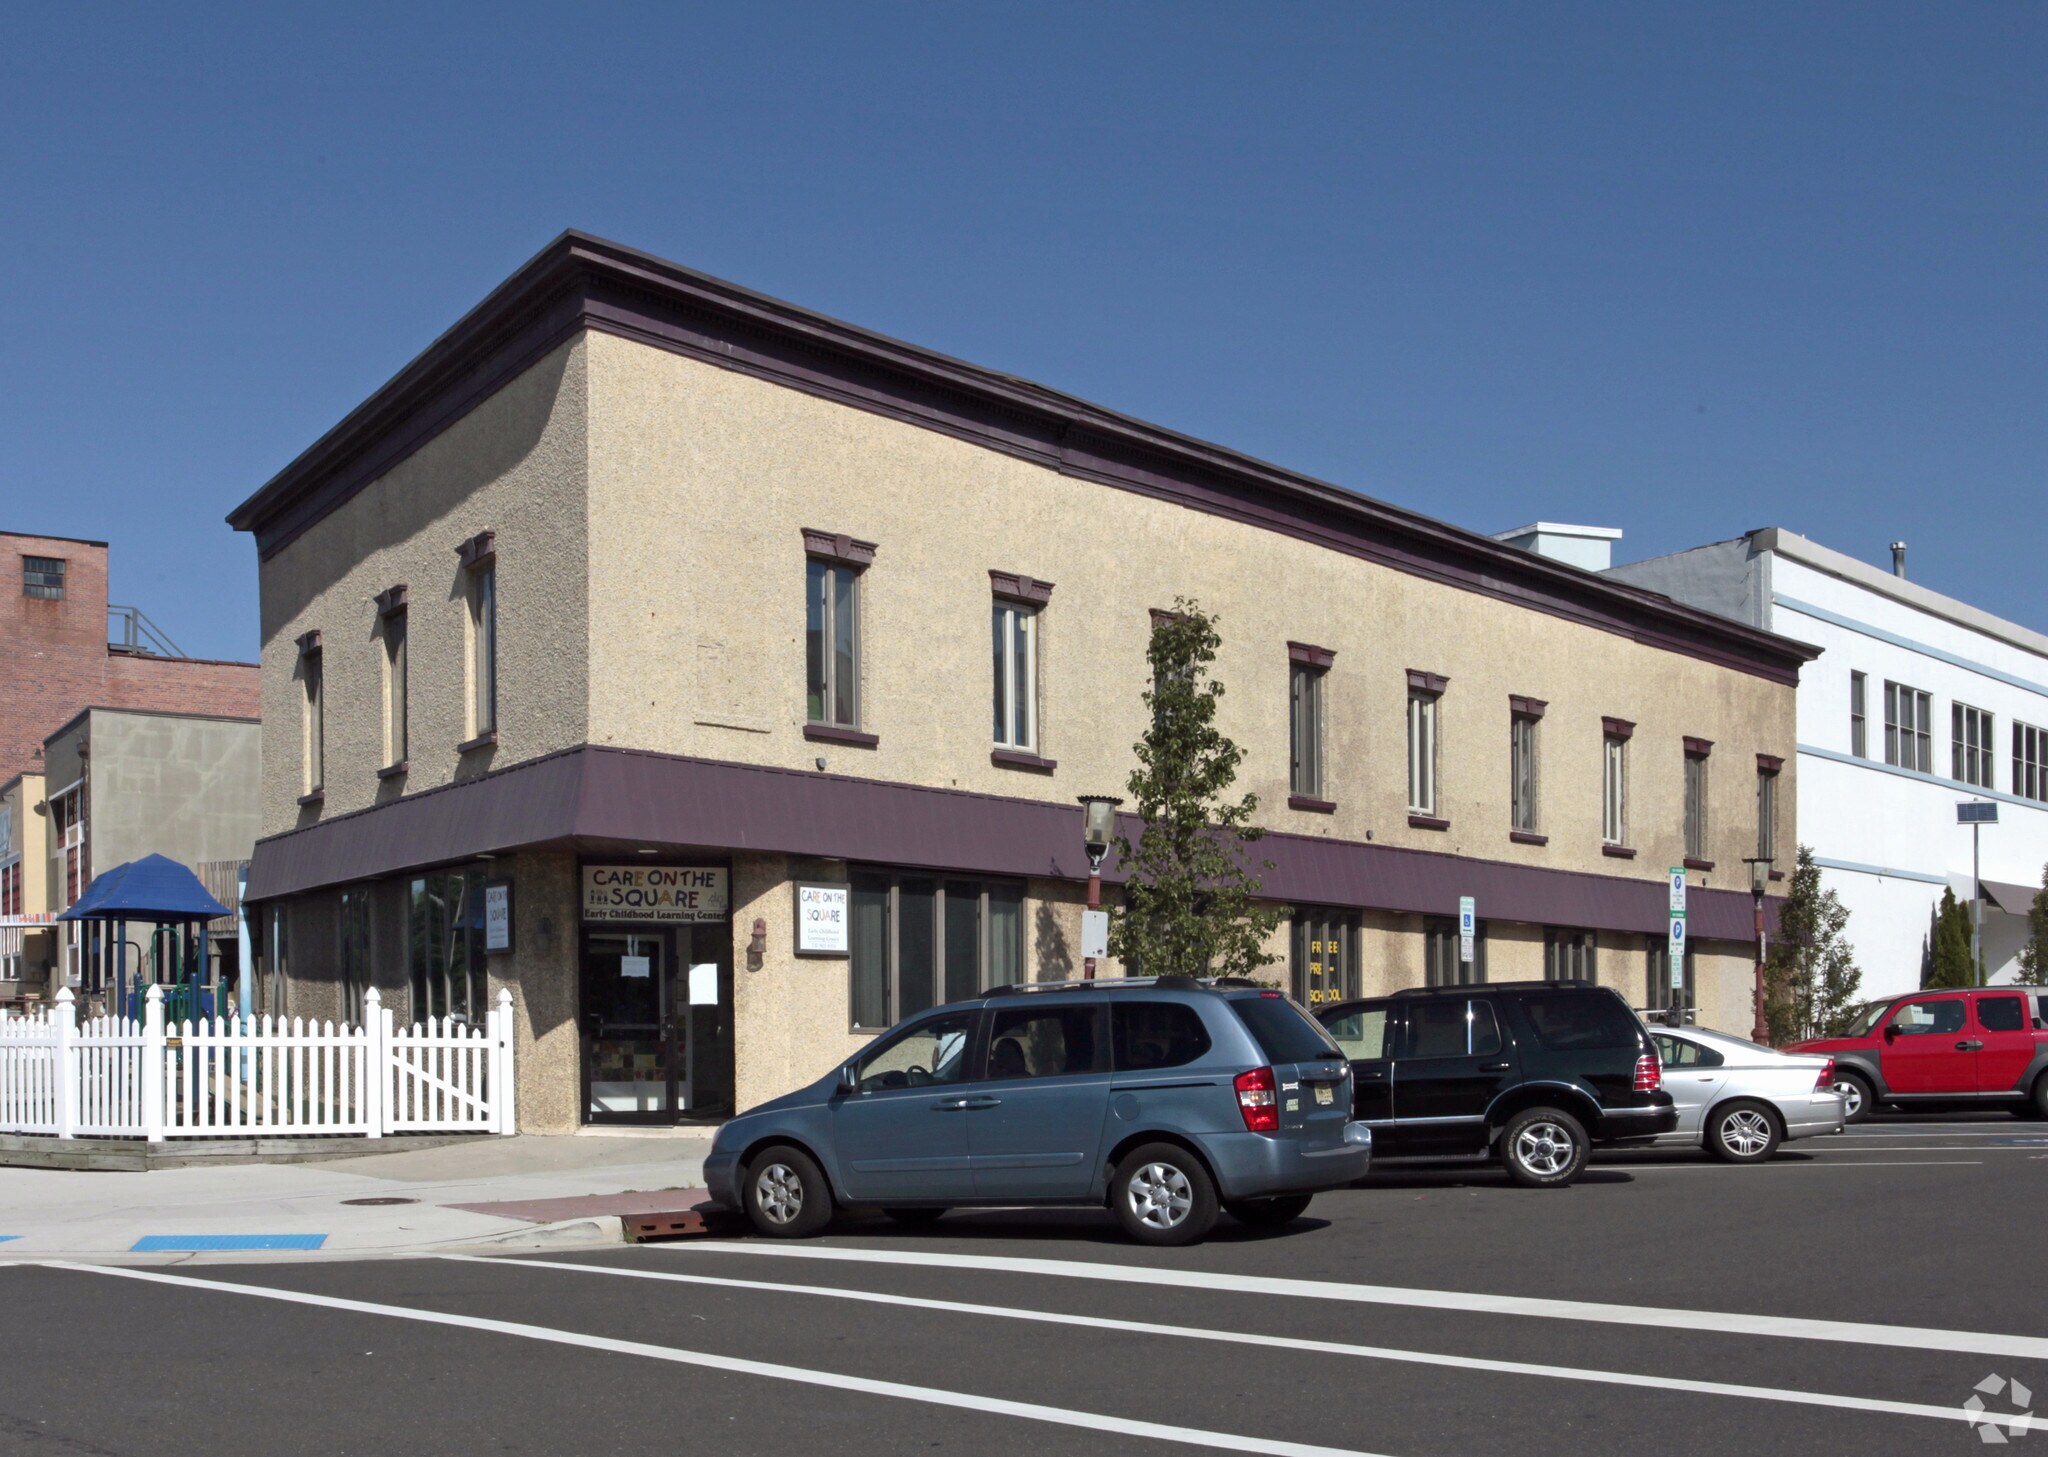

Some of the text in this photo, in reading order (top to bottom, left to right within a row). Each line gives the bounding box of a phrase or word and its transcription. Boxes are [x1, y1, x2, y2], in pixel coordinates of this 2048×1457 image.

[594, 870, 716, 888] CARE ON THE
[610, 888, 700, 908] SQUARE
[802, 890, 846, 904] CARE ON THE
[584, 909, 607, 920] Early
[609, 910, 654, 918] Childhood
[656, 911, 695, 921] Learning
[806, 908, 840, 923] SQUARE
[1311, 940, 1338, 954] FREE
